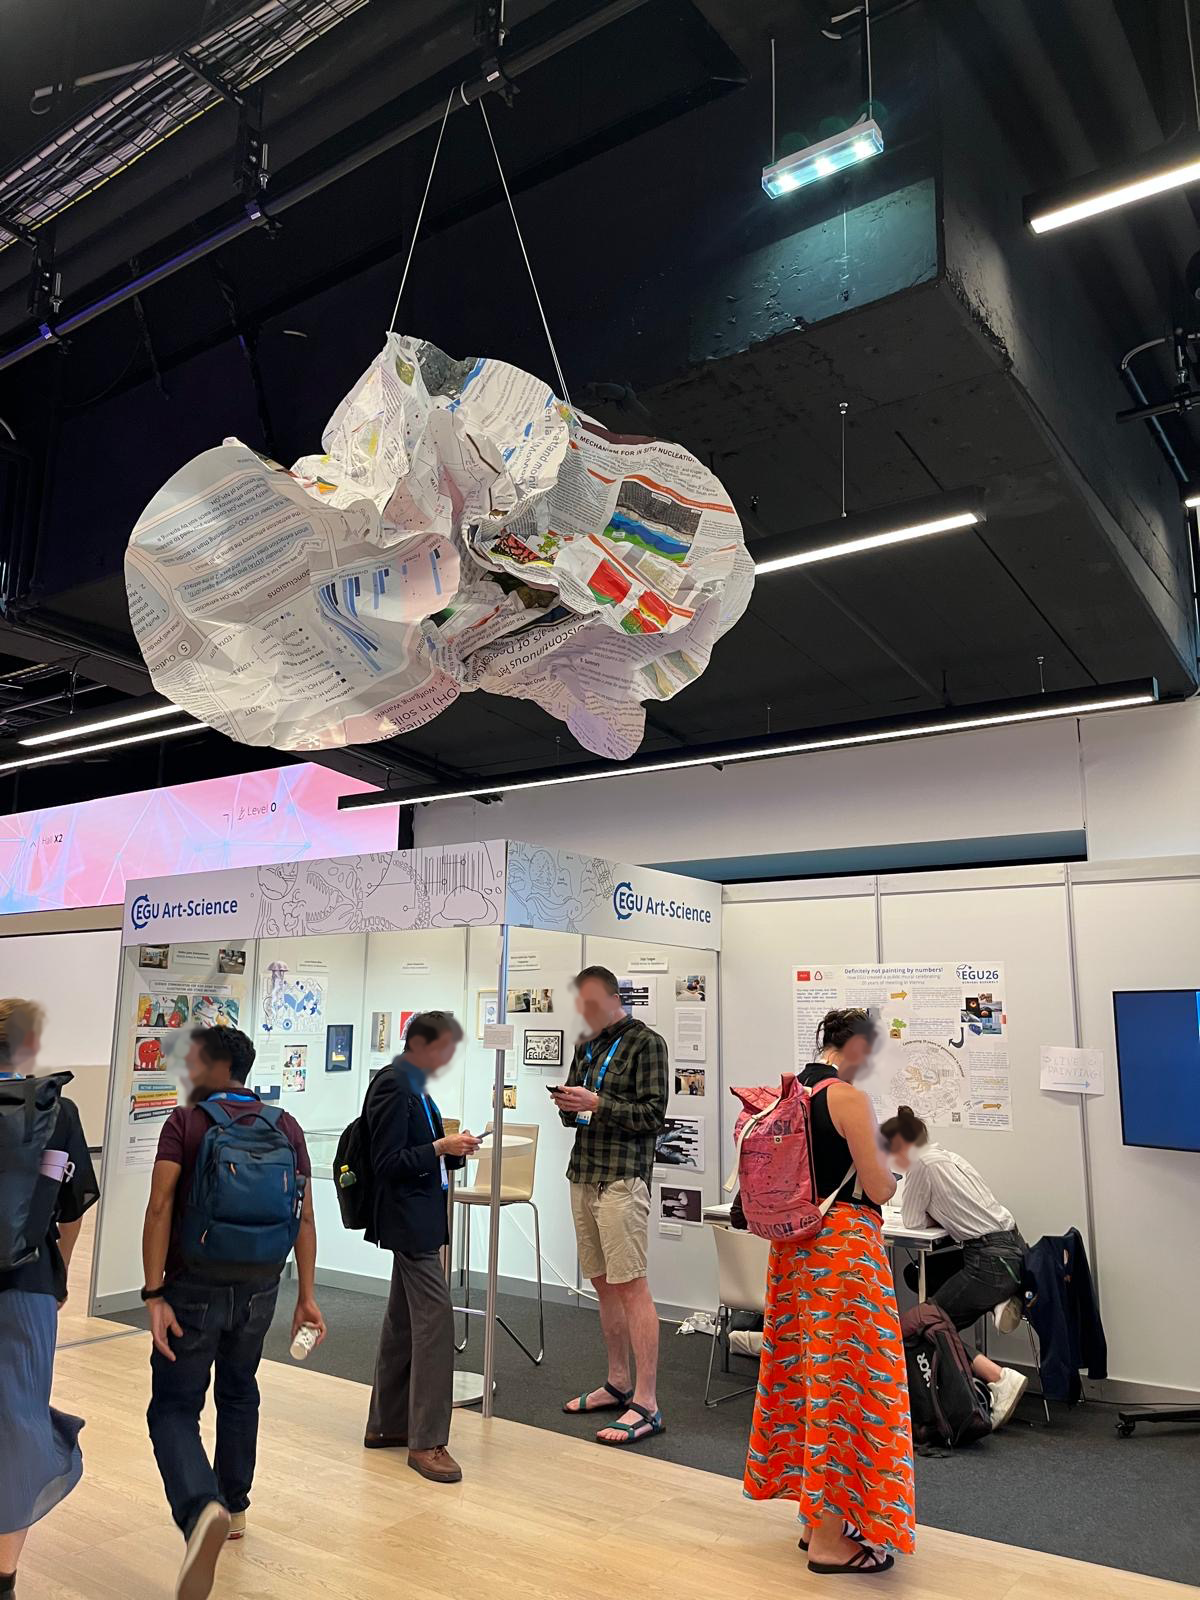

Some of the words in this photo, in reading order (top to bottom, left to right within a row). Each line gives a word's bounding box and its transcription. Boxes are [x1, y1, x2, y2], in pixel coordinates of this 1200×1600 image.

[180, 643, 188, 652] 5
[515, 638, 531, 651] of
[418, 700, 433, 714] in
[388, 708, 418, 729] soils
[54, 833, 63, 843] X2
[136, 902, 160, 920] EGU
[162, 898, 238, 919] Art-Science
[619, 891, 643, 912] EGU
[645, 897, 711, 923] Art-Science
[962, 970, 999, 980] EGU26
